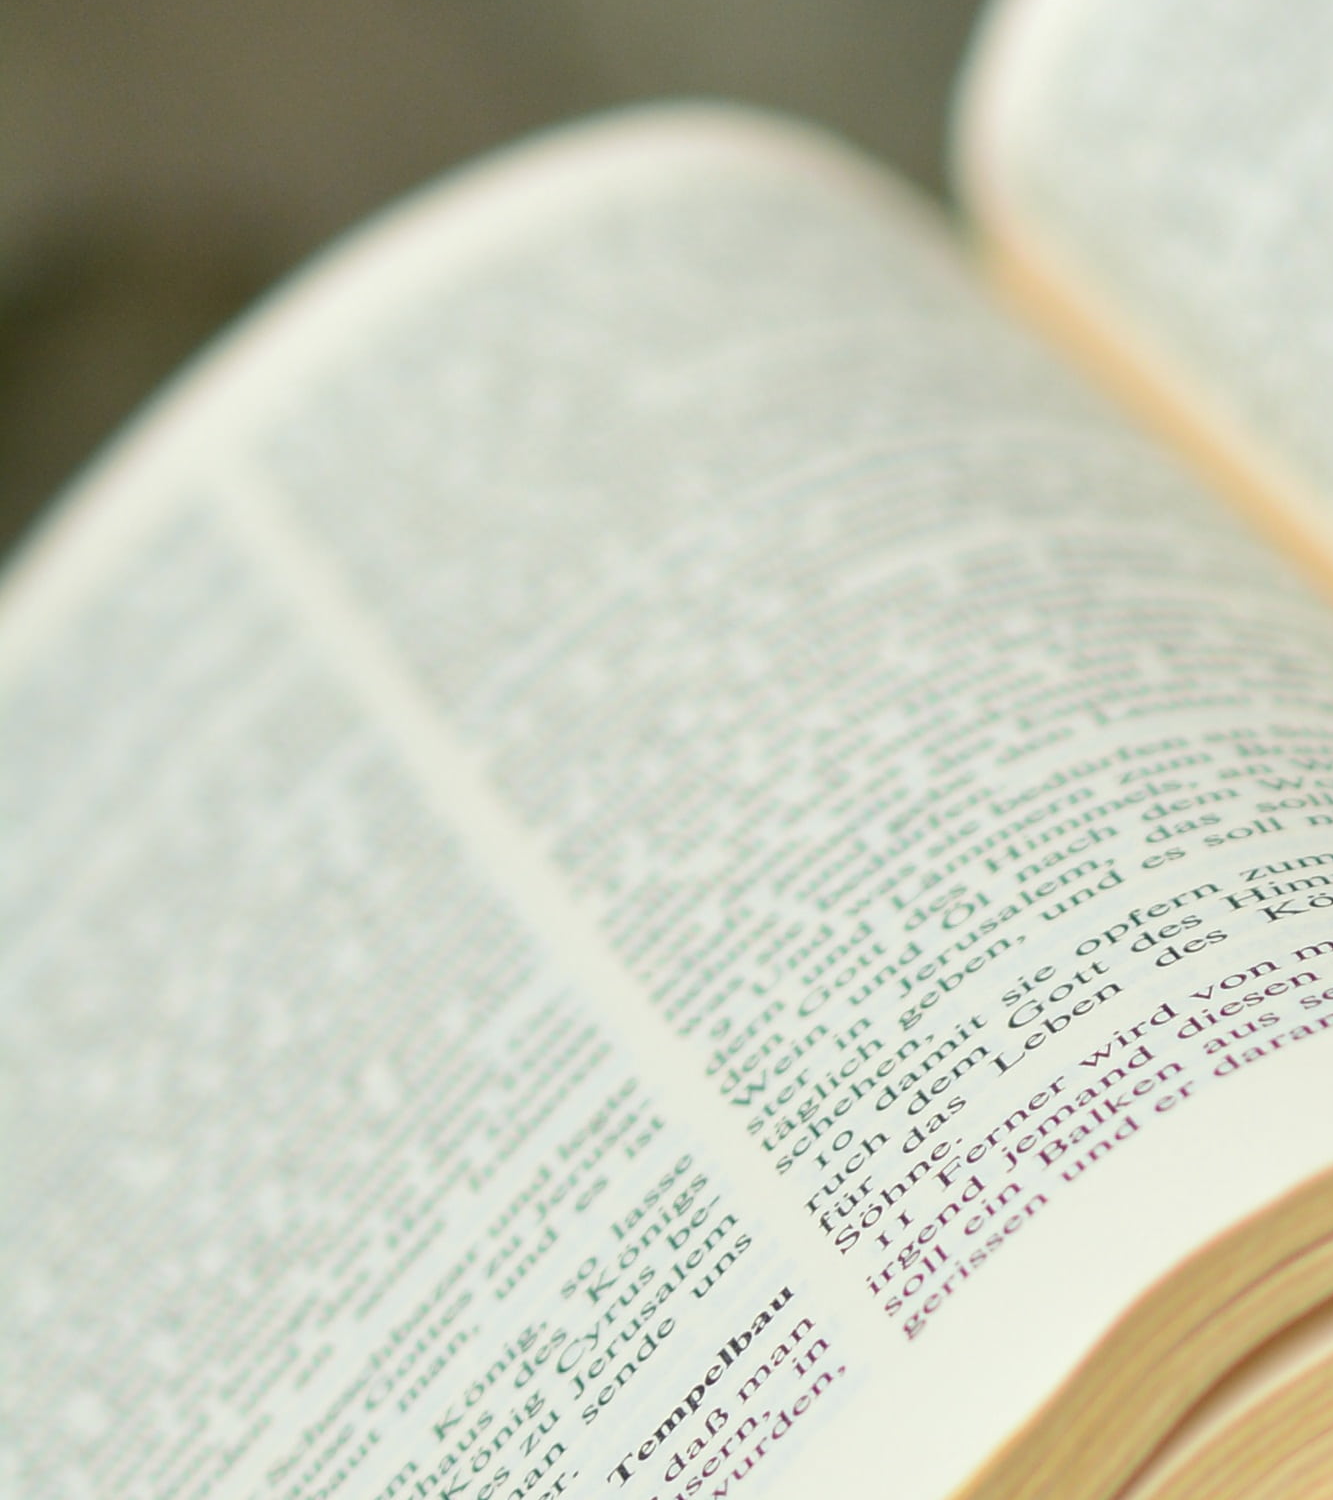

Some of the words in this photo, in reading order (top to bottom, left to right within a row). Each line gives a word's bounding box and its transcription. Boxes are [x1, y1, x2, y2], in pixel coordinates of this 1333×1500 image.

[804, 1132, 890, 1216] ruch
[906, 1045, 991, 1117] dem
[1006, 961, 1110, 1030] Gott
[1129, 913, 1204, 954] des
[818, 1174, 873, 1237] für
[901, 1095, 968, 1155] das
[991, 982, 1124, 1076] Leben
[1154, 928, 1229, 969] des
[874, 1016, 987, 1113] damit
[1000, 964, 1055, 1008] sie
[1074, 882, 1221, 958] opfern
[934, 1074, 1065, 1189] Ferner
[1077, 1002, 1180, 1068] wird
[1188, 960, 1282, 1001] von
[833, 1137, 964, 1256] Söhne.
[865, 1174, 986, 1296] irgend
[1000, 1044, 1156, 1174] jemand
[1176, 971, 1320, 1041] diesen
[883, 1243, 950, 1318] soll
[963, 1182, 1023, 1237] ein
[1036, 1061, 1185, 1168] Balken
[1202, 1011, 1282, 1056] aus
[901, 1193, 1049, 1342] gerissen
[1060, 1115, 1141, 1183] und
[1153, 1080, 1194, 1114] er
[580, 1316, 677, 1427] sende
[690, 1232, 754, 1300] uns
[605, 1285, 796, 1486] Tempelbau
[663, 1406, 730, 1484] daß
[736, 1317, 815, 1404] man
[793, 1337, 831, 1378] in
